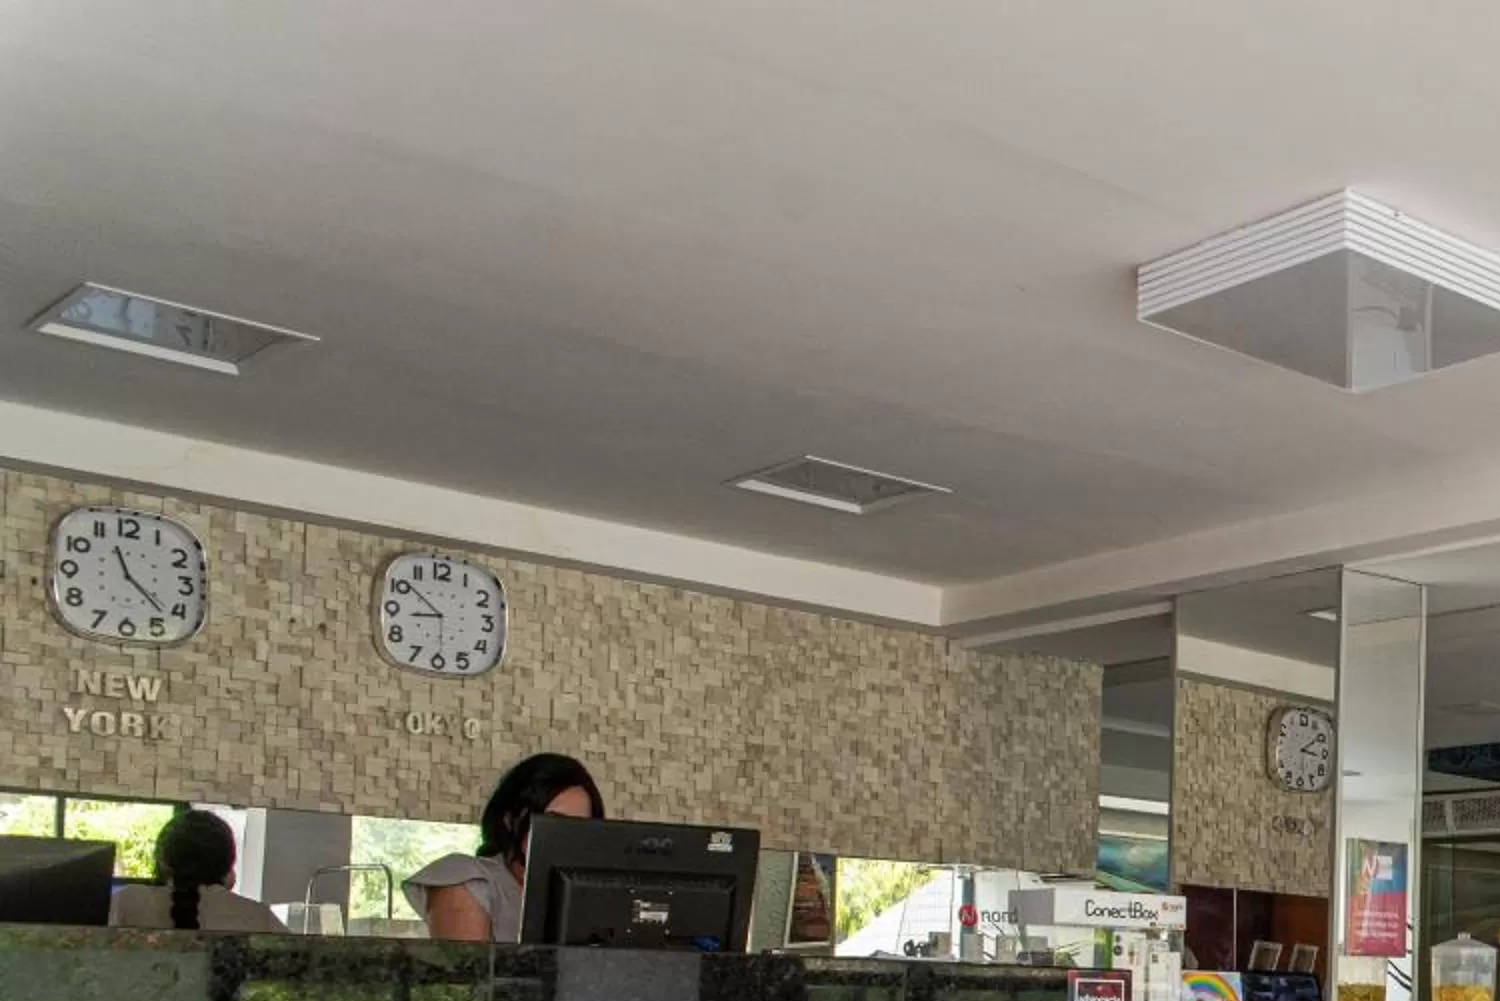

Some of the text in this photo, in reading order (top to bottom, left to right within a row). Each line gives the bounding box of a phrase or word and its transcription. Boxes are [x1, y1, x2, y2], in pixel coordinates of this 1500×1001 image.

[93, 520, 106, 538] 11
[117, 517, 141, 540] 12
[155, 529, 161, 546] 1
[66, 535, 91, 553] 10
[171, 548, 188, 569] 2
[60, 559, 79, 578] 9
[413, 564, 423, 581] 11
[433, 562, 452, 582] 12
[177, 575, 194, 596] 3
[390, 578, 411, 594] 10
[463, 573, 468, 588] 1
[65, 587, 84, 607] 8
[476, 589, 490, 608] 2
[170, 603, 186, 620] 4
[384, 600, 400, 617] 9
[91, 609, 108, 629] 7
[118, 617, 136, 637] 6
[150, 617, 165, 637] 5
[481, 614, 495, 633] 3
[388, 624, 403, 643] 8
[409, 645, 423, 662] 7
[473, 639, 488, 655] 4
[430, 652, 445, 670] 6
[456, 652, 470, 670] 5
[77, 669, 162, 701] NEW
[63, 706, 177, 740] YORK
[1084, 898, 1160, 921] ConectBox
